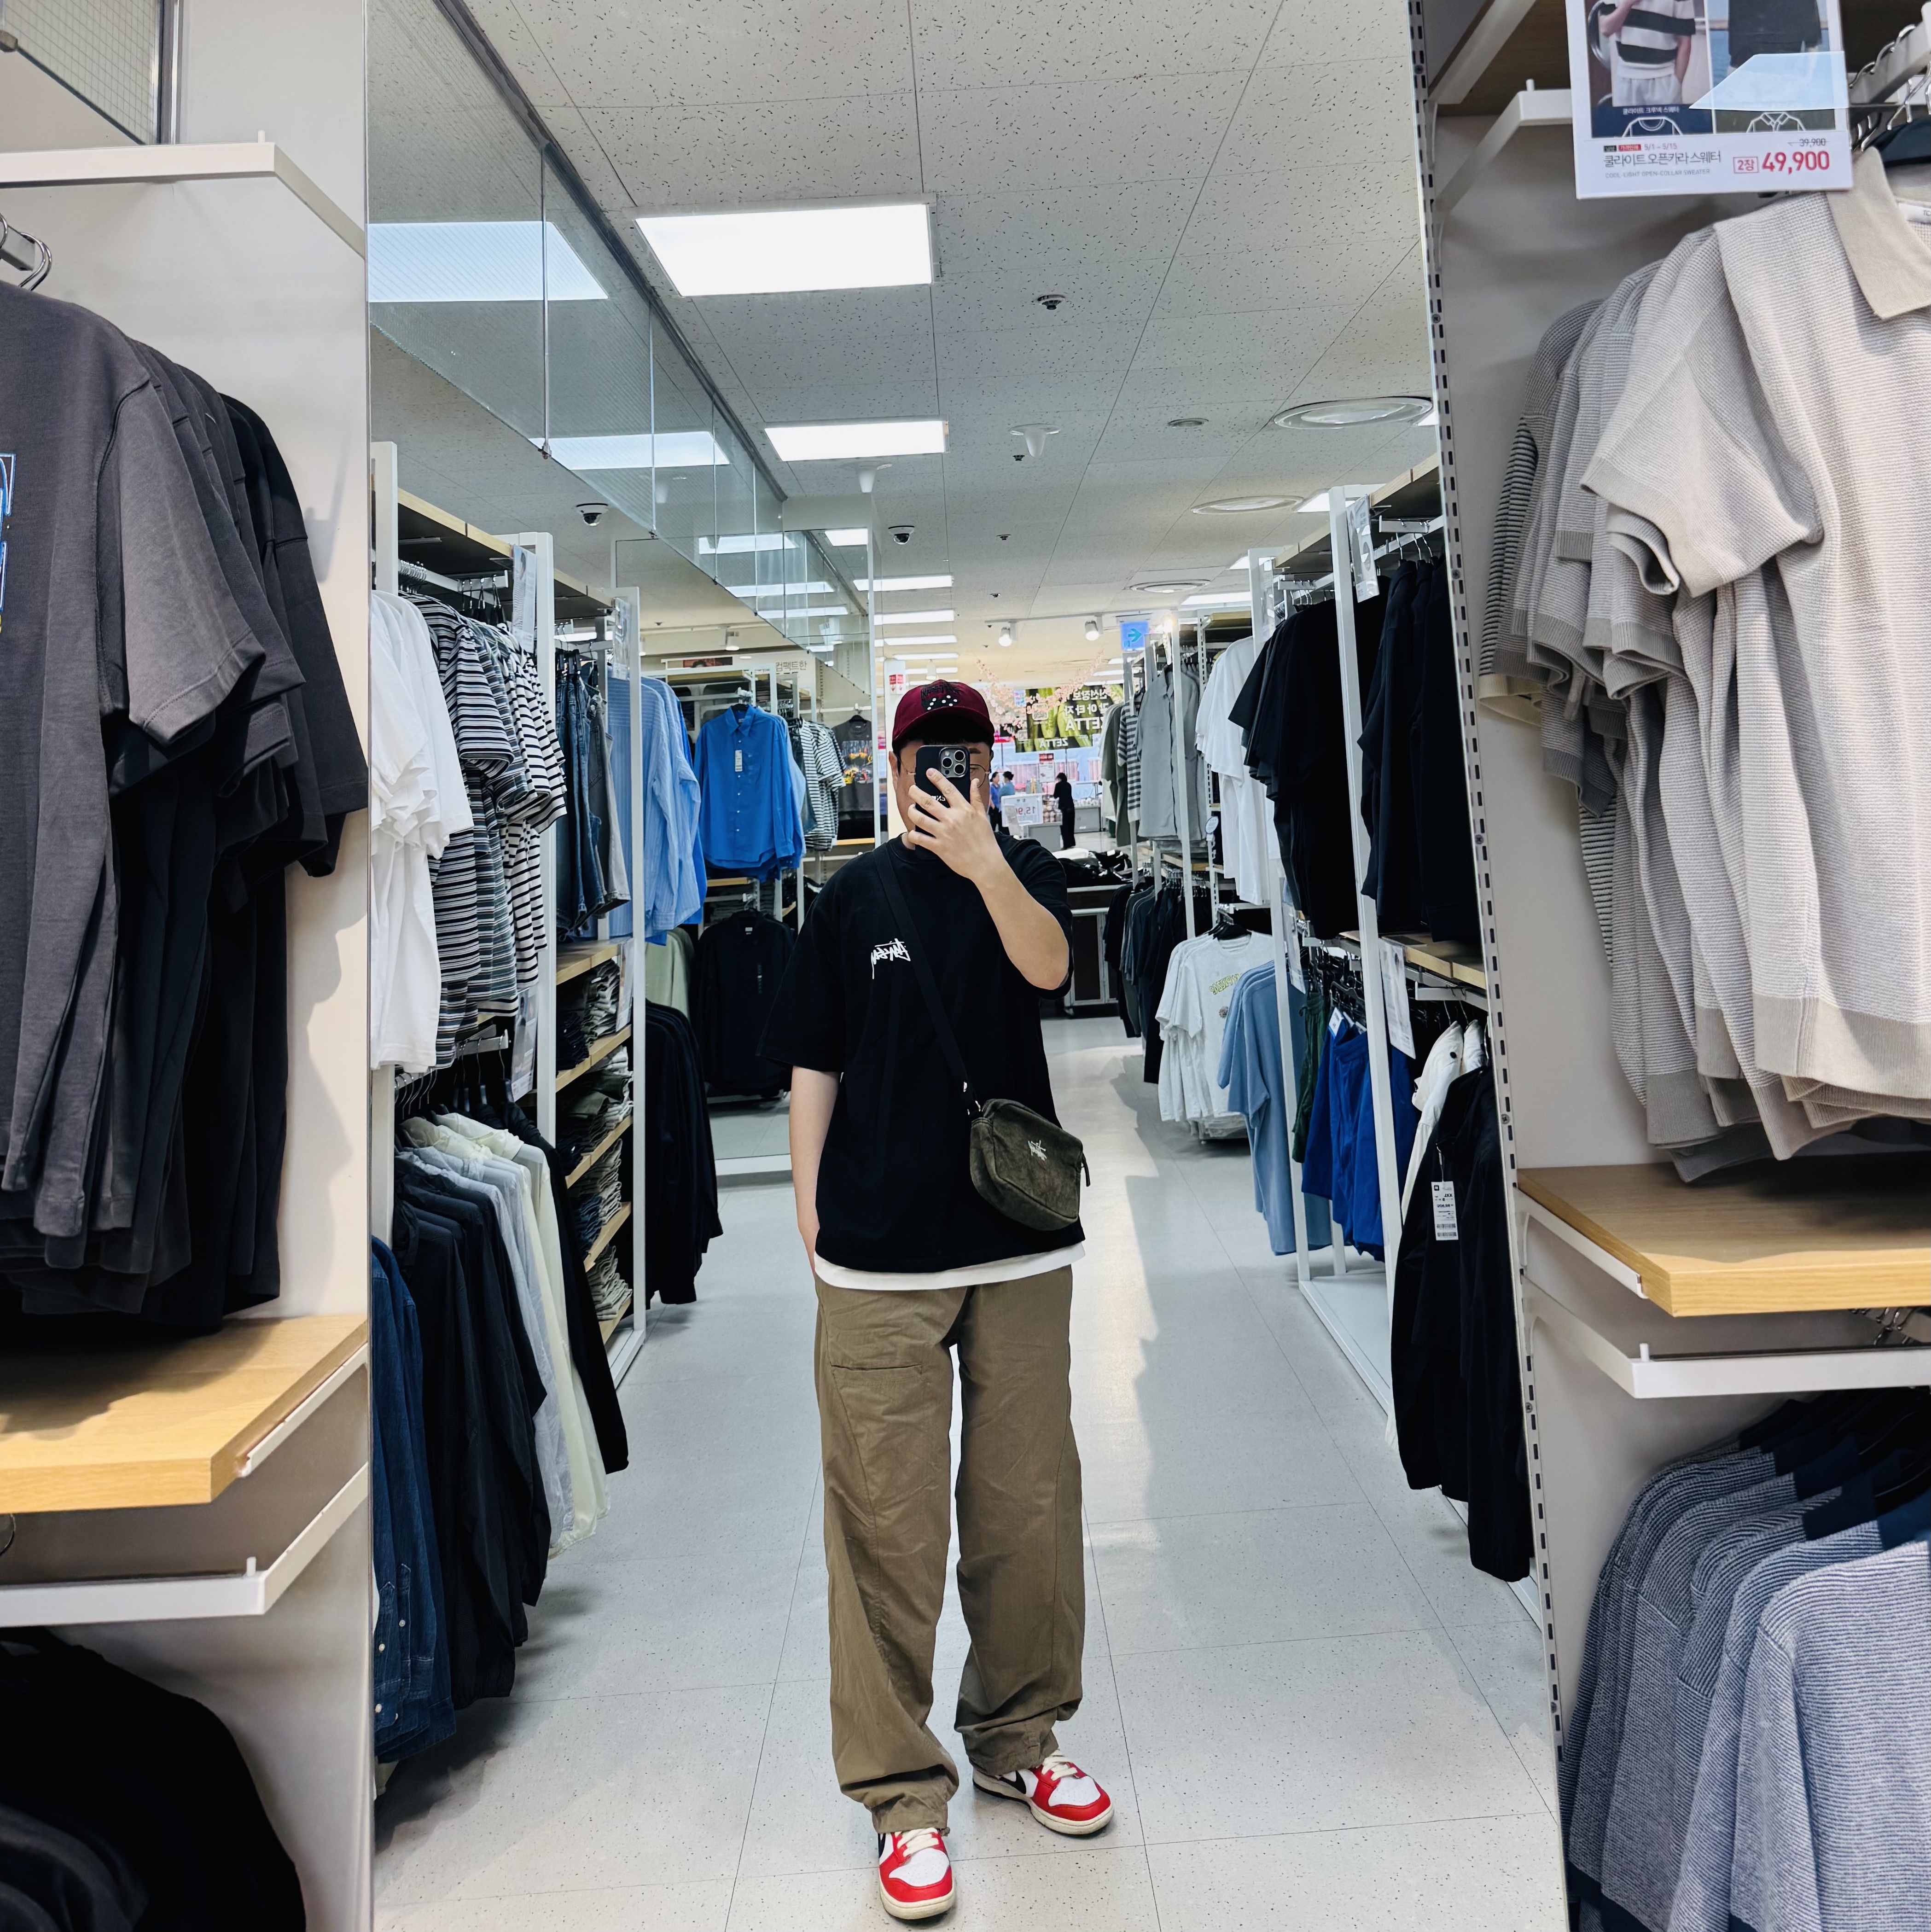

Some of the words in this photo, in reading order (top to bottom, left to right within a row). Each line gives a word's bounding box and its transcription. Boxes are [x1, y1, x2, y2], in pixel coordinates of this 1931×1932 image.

[1799, 138, 1826, 147] 39,900
[1604, 154, 1646, 168] 쿨라이트
[1648, 152, 1688, 165] 오픈카라
[1690, 151, 1721, 163] 스웨터
[1737, 159, 1755, 171] 2장
[1762, 151, 1830, 175] 49,900
[775, 660, 807, 672] 컴팩트한
